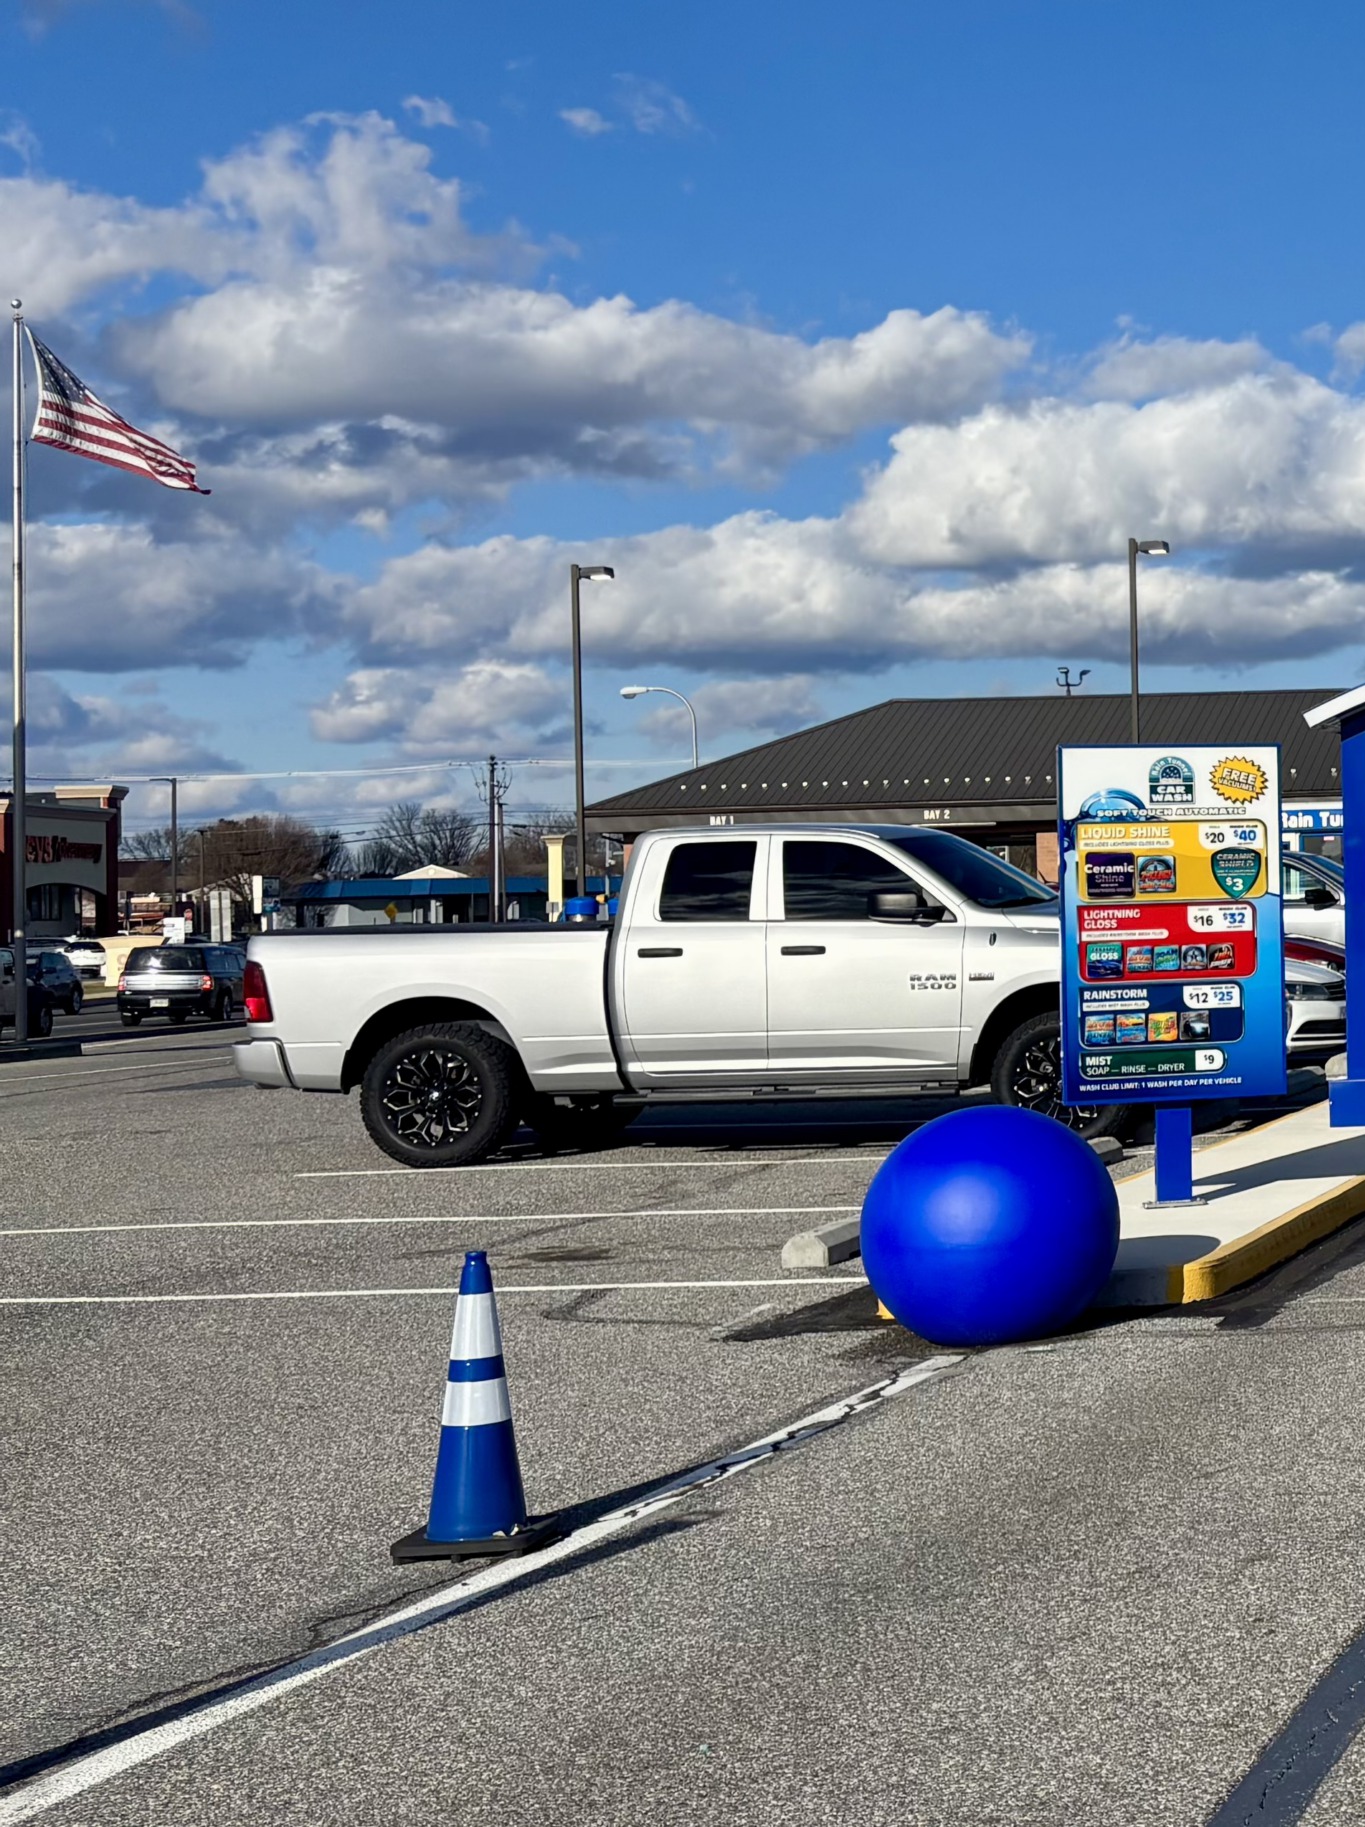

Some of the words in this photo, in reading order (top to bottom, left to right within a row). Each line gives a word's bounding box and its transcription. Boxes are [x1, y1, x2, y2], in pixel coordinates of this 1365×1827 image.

[1222, 767, 1257, 785] FREE
[1157, 786, 1185, 794] CAR
[1218, 777, 1257, 792] VACUUMS!
[1151, 794, 1192, 802] WASH
[924, 810, 940, 820] BAY
[944, 809, 950, 819] 2
[1097, 809, 1128, 817] SOFT
[1132, 808, 1172, 817] TOUCH
[1175, 807, 1246, 816] AUTOMATIC
[709, 816, 727, 826] BAY
[1081, 827, 1126, 839] LIQUID
[1129, 826, 1170, 838] SHINE
[1205, 832, 1225, 843] $20
[1233, 829, 1256, 841] $40
[1084, 862, 1134, 874] Ceramic
[1095, 874, 1125, 883] Shine
[1225, 877, 1244, 891] $3
[1084, 909, 1141, 919] LIGHTNING
[1223, 912, 1246, 924] $32
[1084, 919, 1118, 929] GLOSS
[1194, 915, 1214, 926] $16
[1089, 952, 1119, 961] GLOSS
[909, 973, 957, 982] RAM
[910, 981, 957, 991] 1500
[1083, 989, 1147, 1000] RAINSTORM
[1189, 992, 1208, 1004] $12
[1213, 991, 1233, 1002] $25
[1085, 1056, 1112, 1066] MIST
[1204, 1054, 1215, 1064] $9
[1086, 1067, 1109, 1075] SOAP
[1121, 1065, 1146, 1073] RINSE
[1158, 1063, 1185, 1072] DRYER
